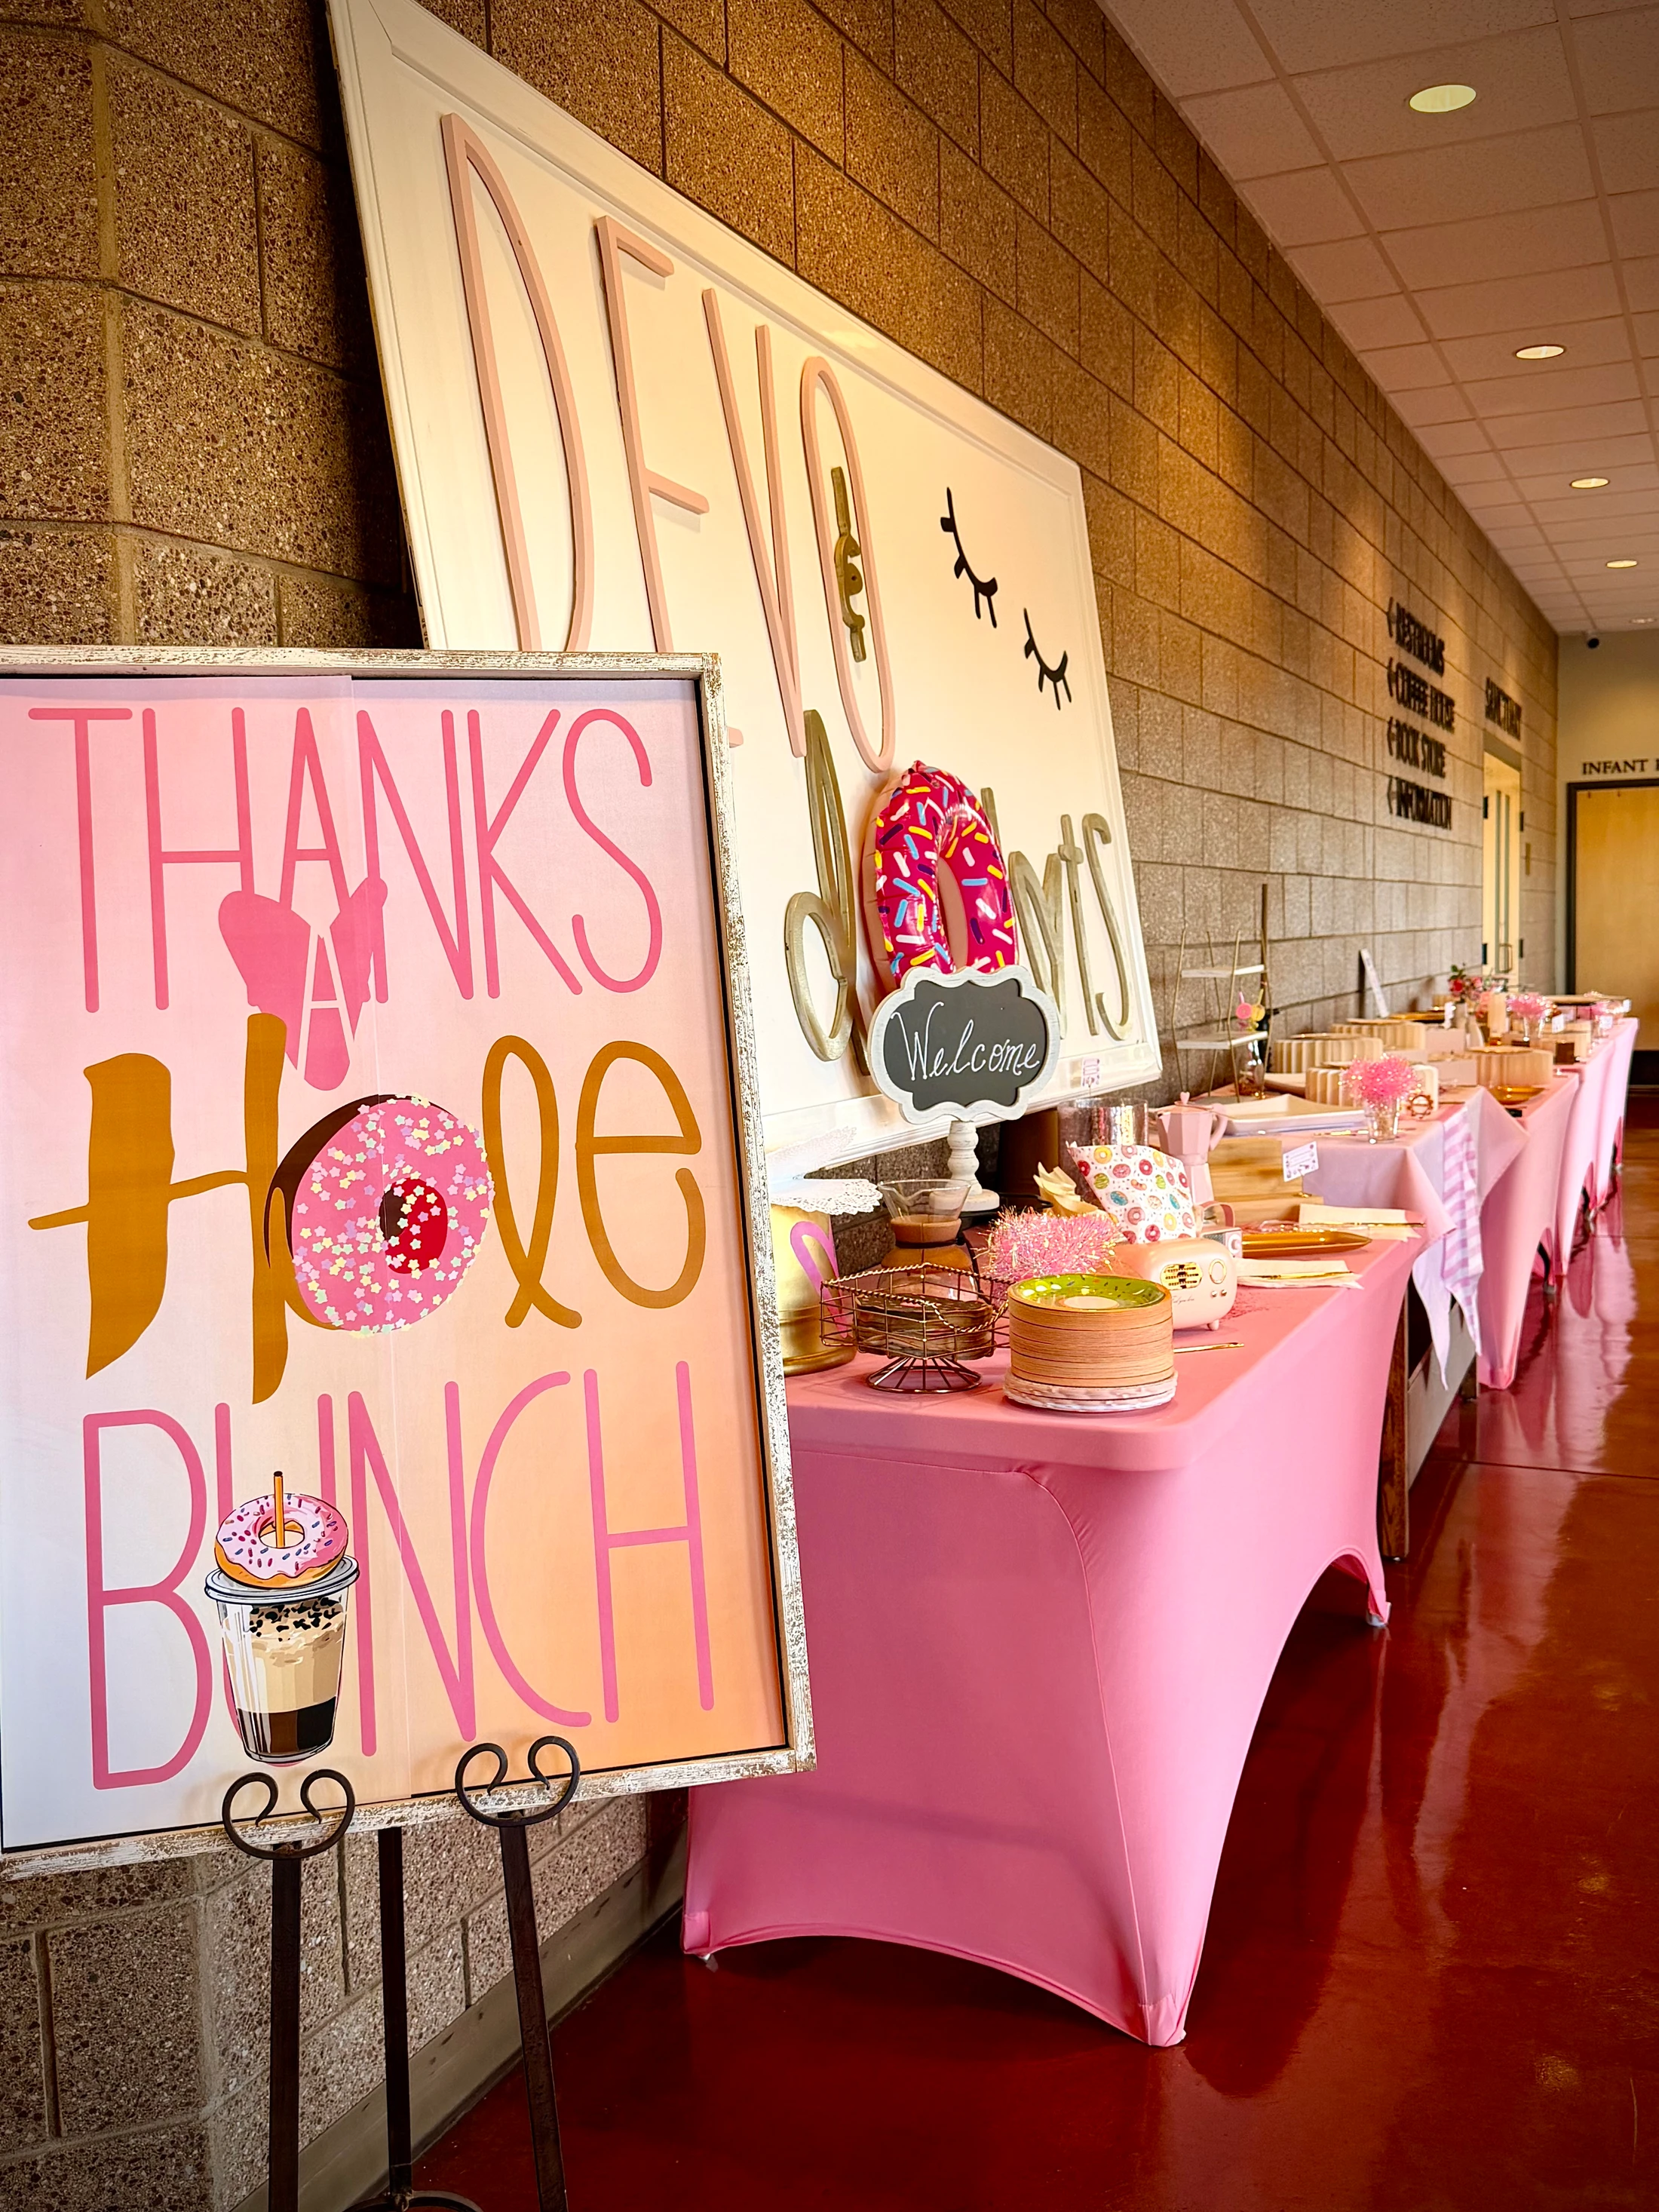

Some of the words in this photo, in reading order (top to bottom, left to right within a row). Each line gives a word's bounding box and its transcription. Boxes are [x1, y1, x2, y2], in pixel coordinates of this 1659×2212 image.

[442, 113, 896, 772] DEVO
[1395, 602, 1445, 677] RESTROOMS
[1396, 661, 1428, 719] COFFEE
[1430, 684, 1455, 735] HOUSE
[1484, 676, 1523, 741] SANCTUARY
[1395, 718, 1420, 769] BOOK
[1421, 732, 1446, 779] STORE
[1582, 758, 1648, 775] INFANT
[1395, 777, 1452, 831] INFORMATION
[28, 707, 663, 1014] THANKS
[889, 1001, 1040, 1081] Welcome
